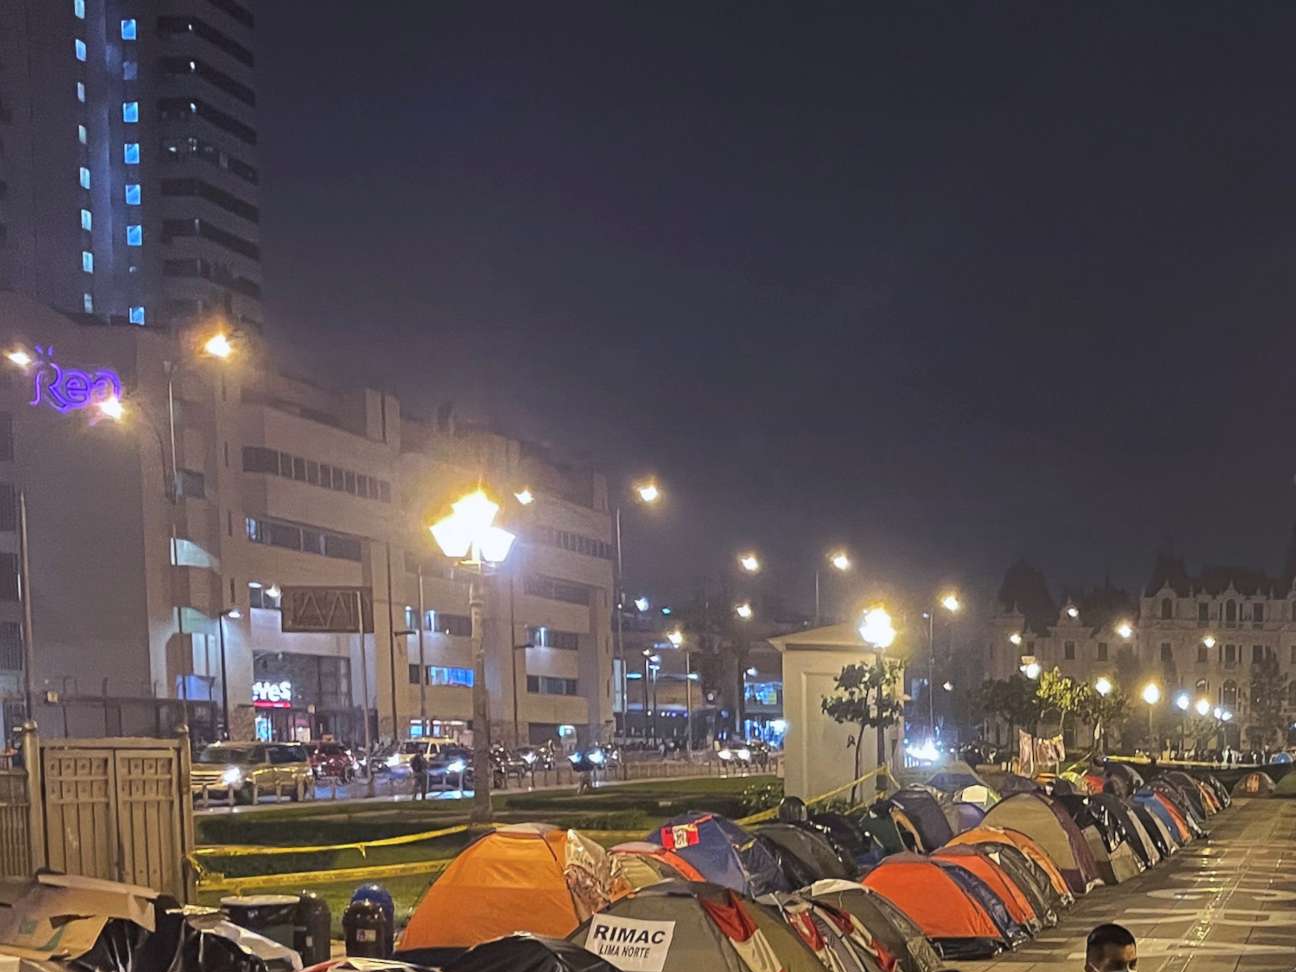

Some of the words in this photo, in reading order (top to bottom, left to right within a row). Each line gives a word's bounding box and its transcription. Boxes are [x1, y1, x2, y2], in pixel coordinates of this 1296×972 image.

[593, 925, 665, 944] RIMAC
[600, 944, 619, 956] LIMA
[621, 945, 651, 958] NORTE
